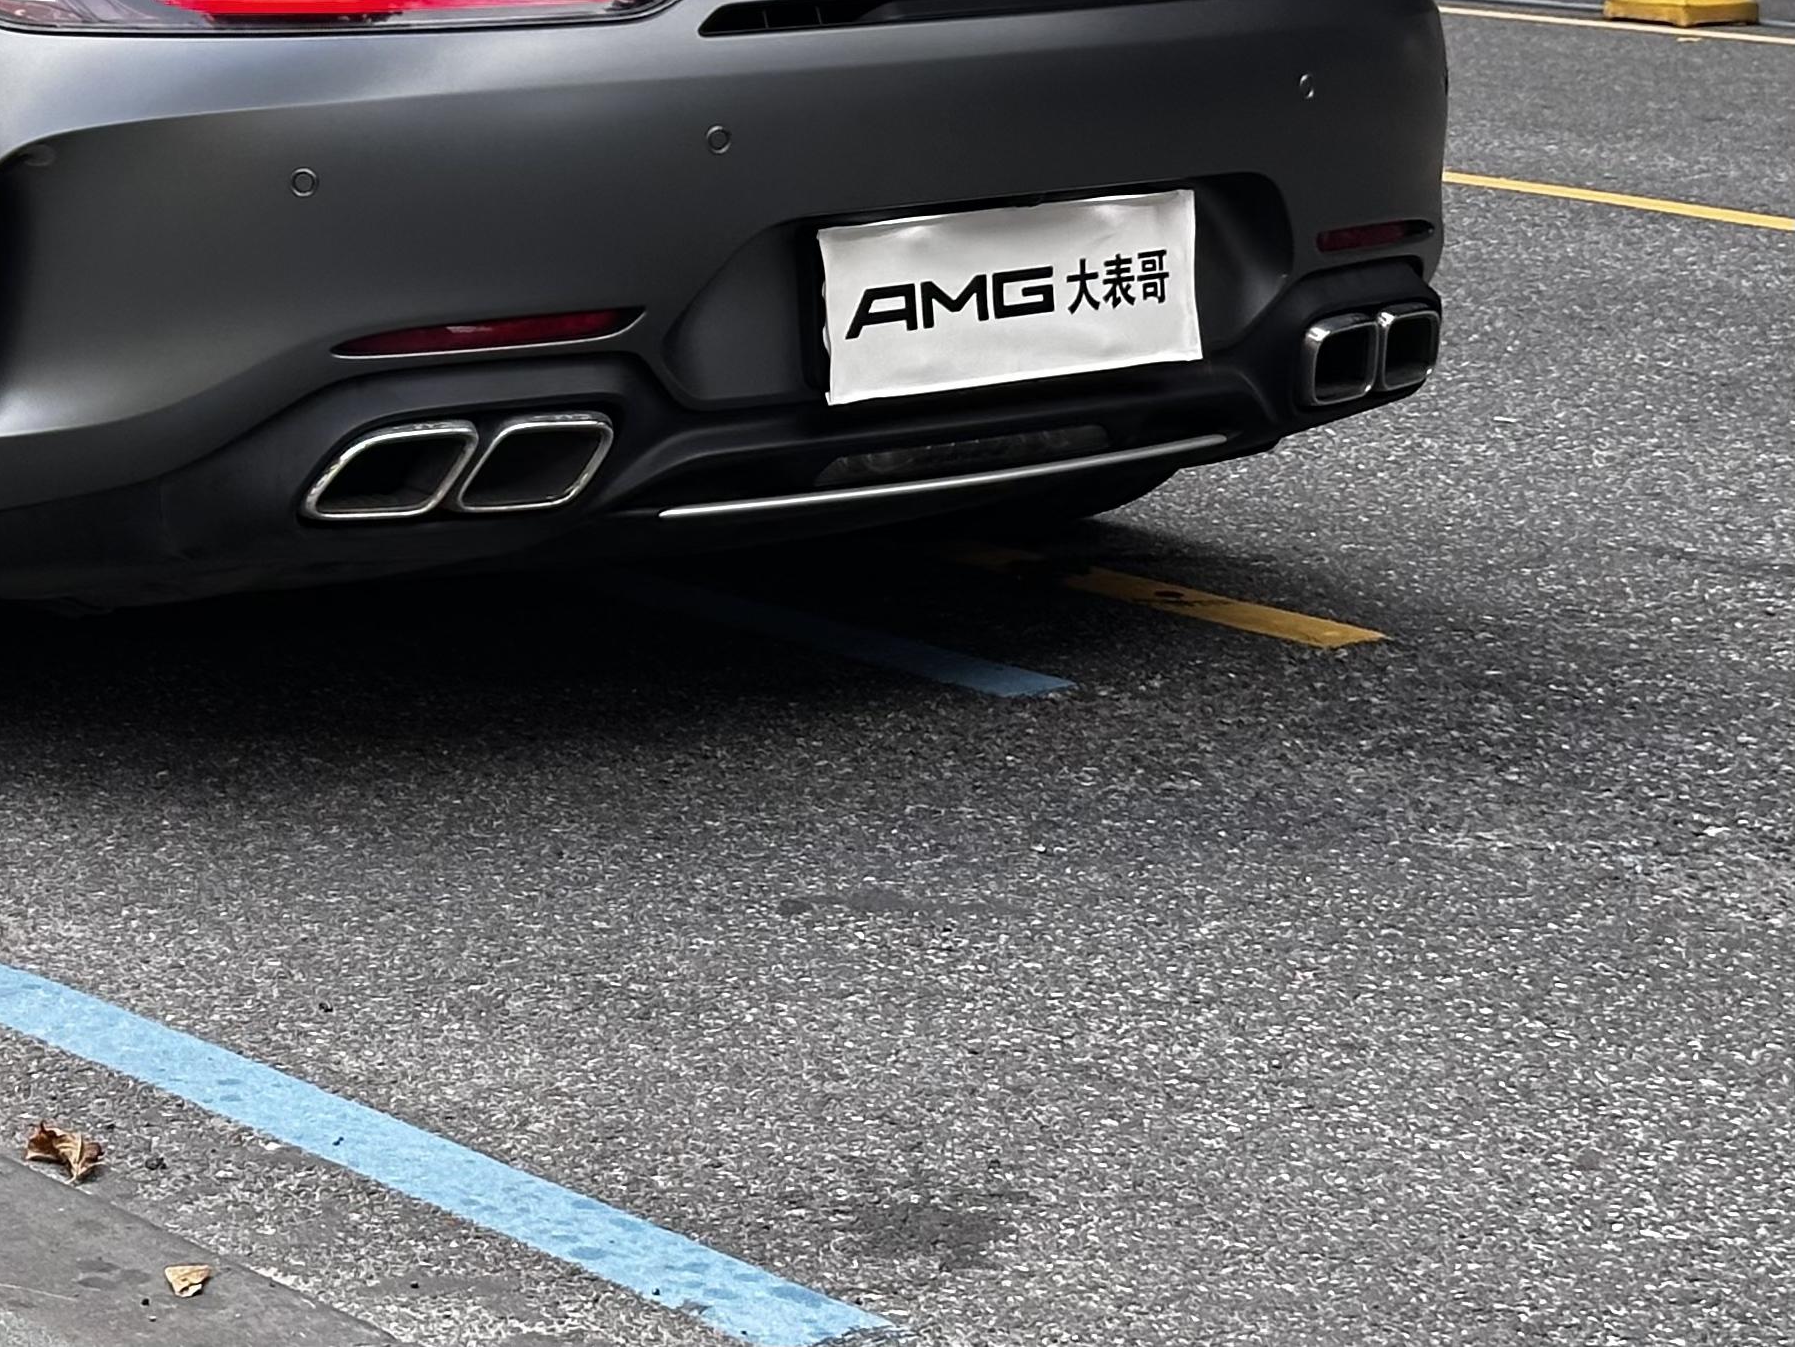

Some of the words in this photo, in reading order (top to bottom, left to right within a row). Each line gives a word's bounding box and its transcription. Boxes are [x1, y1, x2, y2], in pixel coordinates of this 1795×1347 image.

[845, 265, 1055, 341] AMG
[1066, 249, 1170, 315] 大表哥
